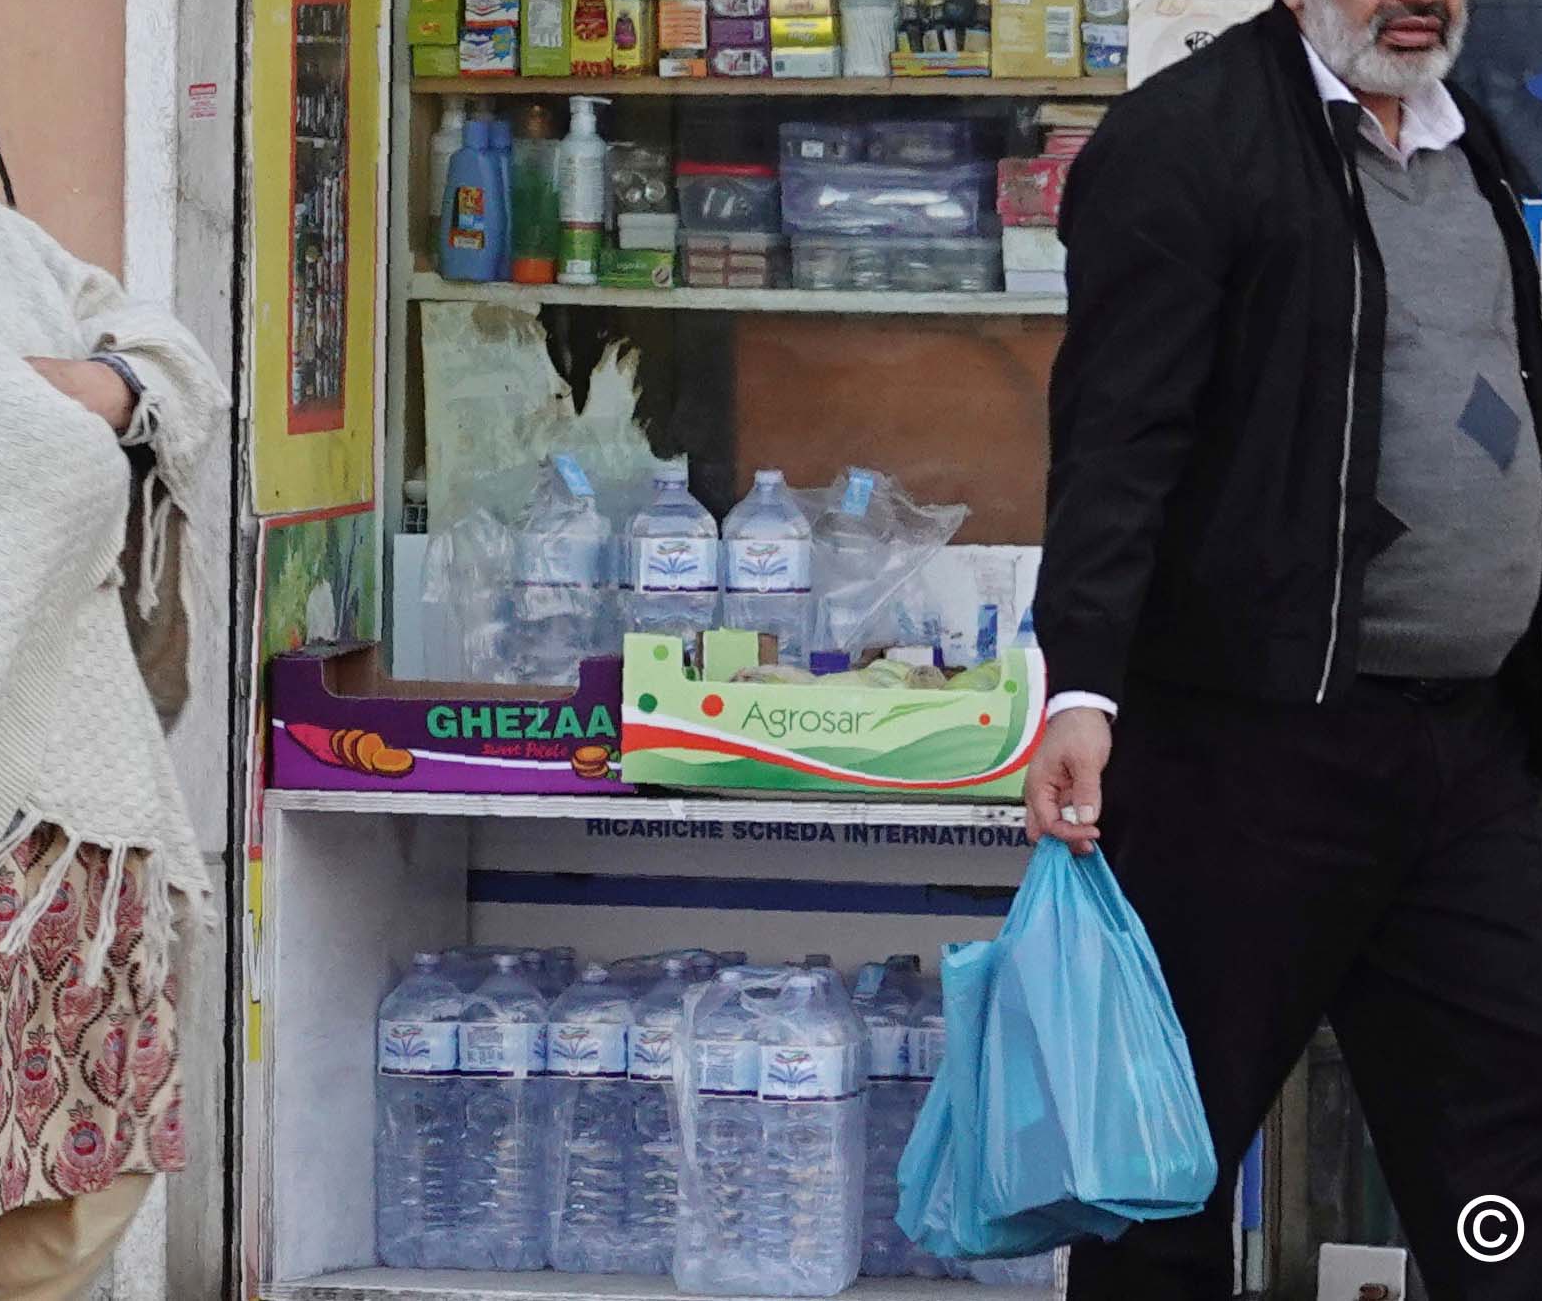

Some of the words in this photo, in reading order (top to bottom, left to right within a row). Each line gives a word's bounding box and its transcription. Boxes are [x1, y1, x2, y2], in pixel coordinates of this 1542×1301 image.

[426, 704, 618, 740] GHEZAA
[741, 700, 874, 739] Agrosar
[585, 817, 724, 840] RICARICHE
[732, 820, 836, 843] SCHEDA
[844, 822, 1030, 848] INTERNATIONA
